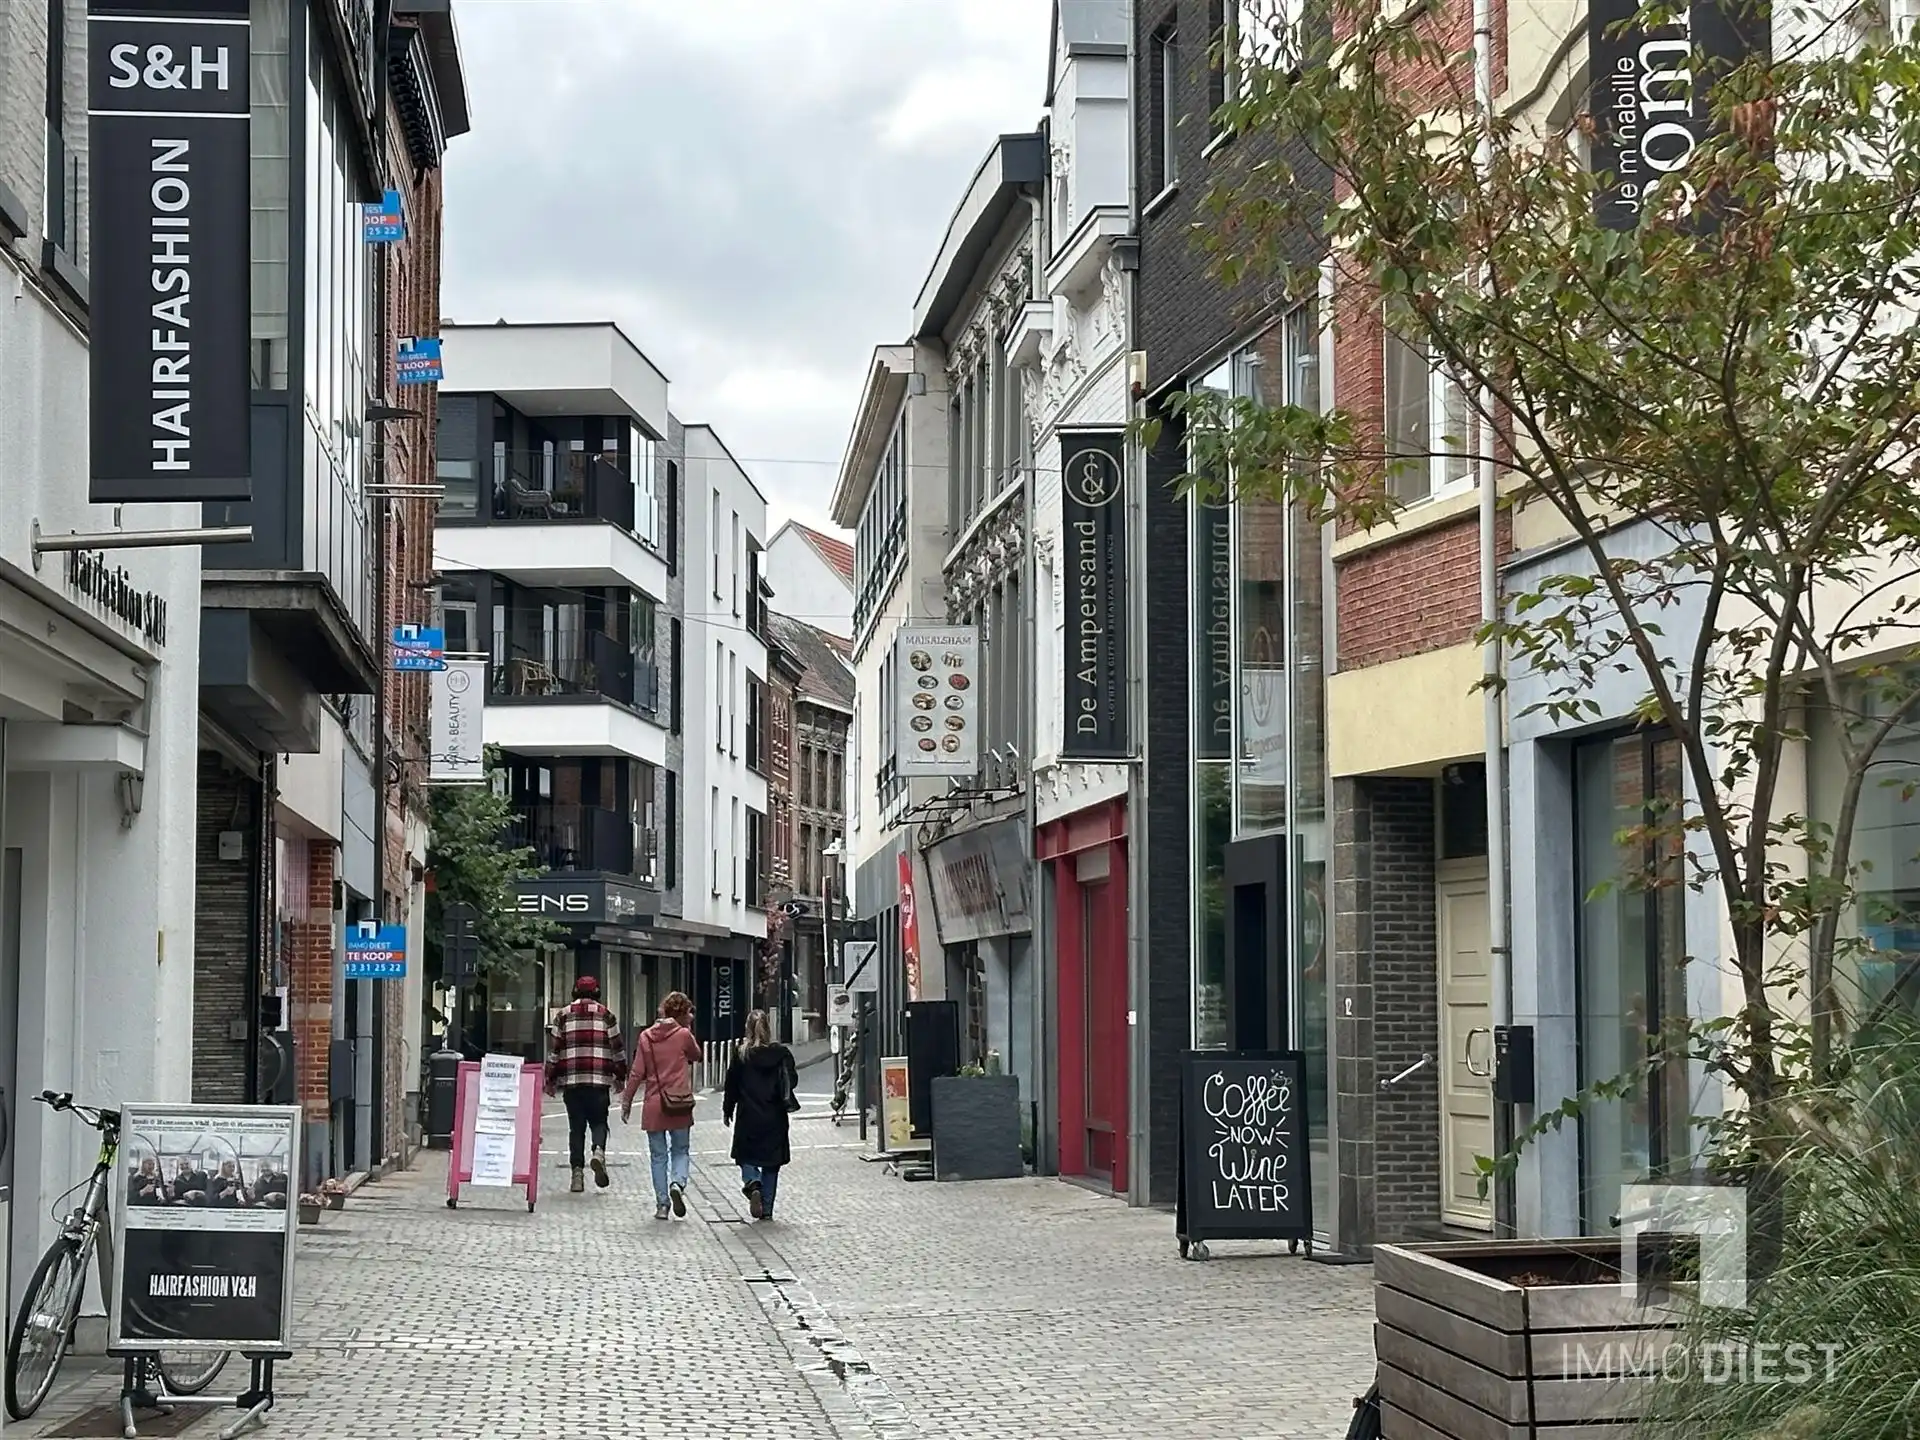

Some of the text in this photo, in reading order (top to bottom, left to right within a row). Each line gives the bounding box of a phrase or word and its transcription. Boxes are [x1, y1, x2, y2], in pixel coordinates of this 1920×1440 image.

[109, 43, 229, 91] S&H
[1615, 183, 1638, 212] Je
[150, 137, 191, 471] HAIRFASHION
[1073, 519, 1103, 734] De Ampersand
[449, 694, 459, 735] BEAUTY
[347, 952, 392, 960] TE KOOP
[360, 963, 371, 971] 31
[374, 963, 386, 971] 25
[389, 963, 401, 971] 22
[1204, 1071, 1291, 1126] Coffee
[1230, 1126, 1275, 1146] NOW
[1209, 1143, 1288, 1182] Wine
[1213, 1181, 1289, 1211] LATER
[150, 1274, 257, 1298] HAIRFASHION V&H
